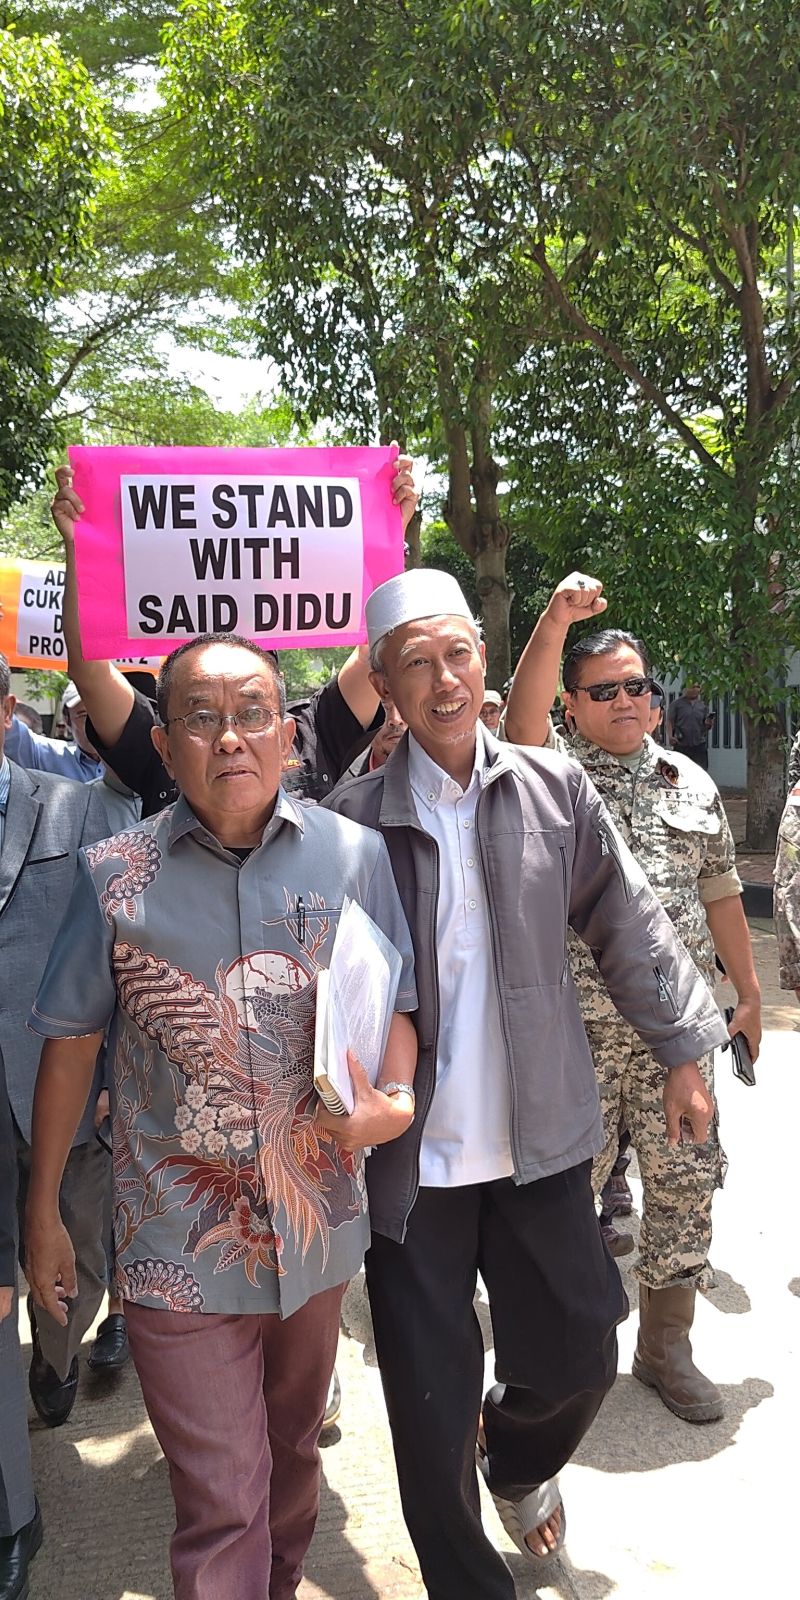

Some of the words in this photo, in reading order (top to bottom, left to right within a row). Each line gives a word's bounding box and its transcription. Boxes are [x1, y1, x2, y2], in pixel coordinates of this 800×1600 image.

[129, 485, 197, 529] WE
[212, 485, 353, 529] STAND
[189, 538, 300, 580] WITH
[23, 588, 63, 609] CUK
[138, 594, 239, 634] SAID
[254, 592, 352, 631] DIDU
